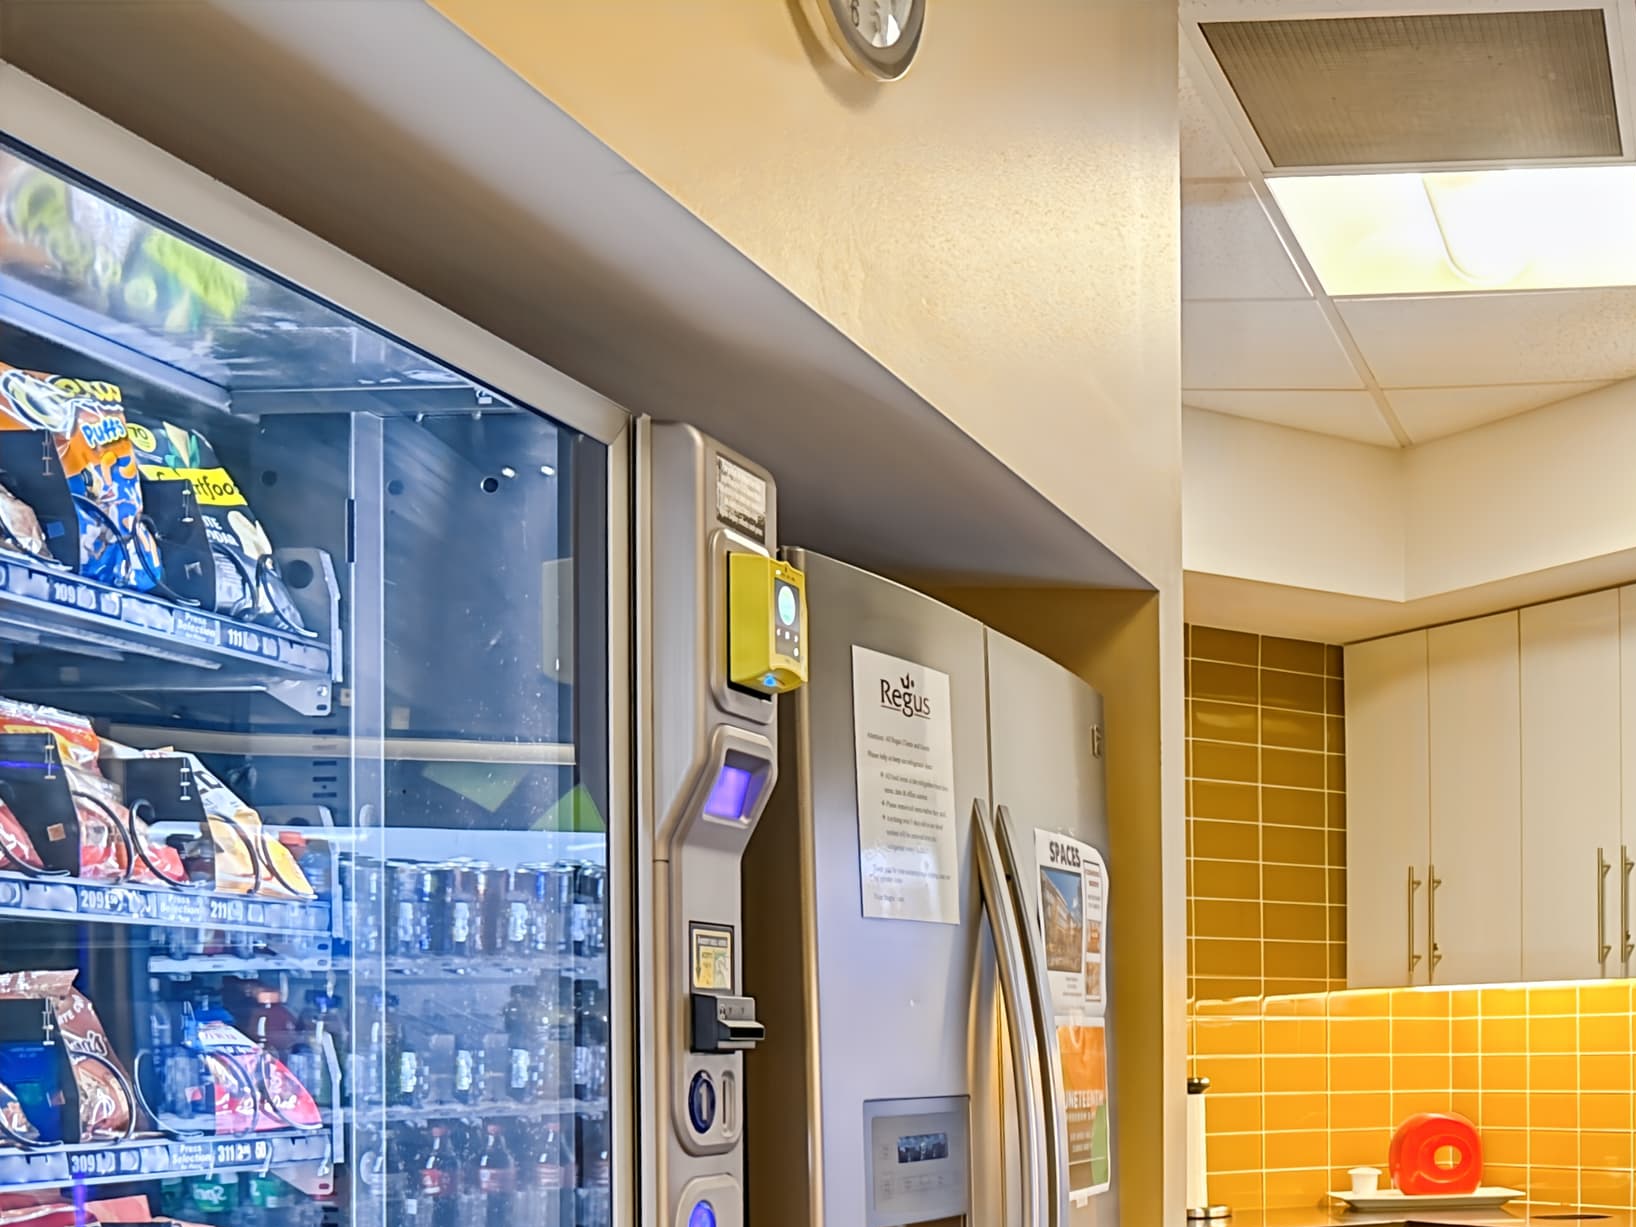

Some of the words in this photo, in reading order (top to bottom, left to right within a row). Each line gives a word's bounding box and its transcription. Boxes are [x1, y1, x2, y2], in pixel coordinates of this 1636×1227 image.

[80, 417, 127, 448] Puffs
[54, 582, 77, 603] 109
[880, 678, 931, 719] Regus
[1049, 840, 1082, 868] SPACES
[71, 1153, 96, 1174] 309
